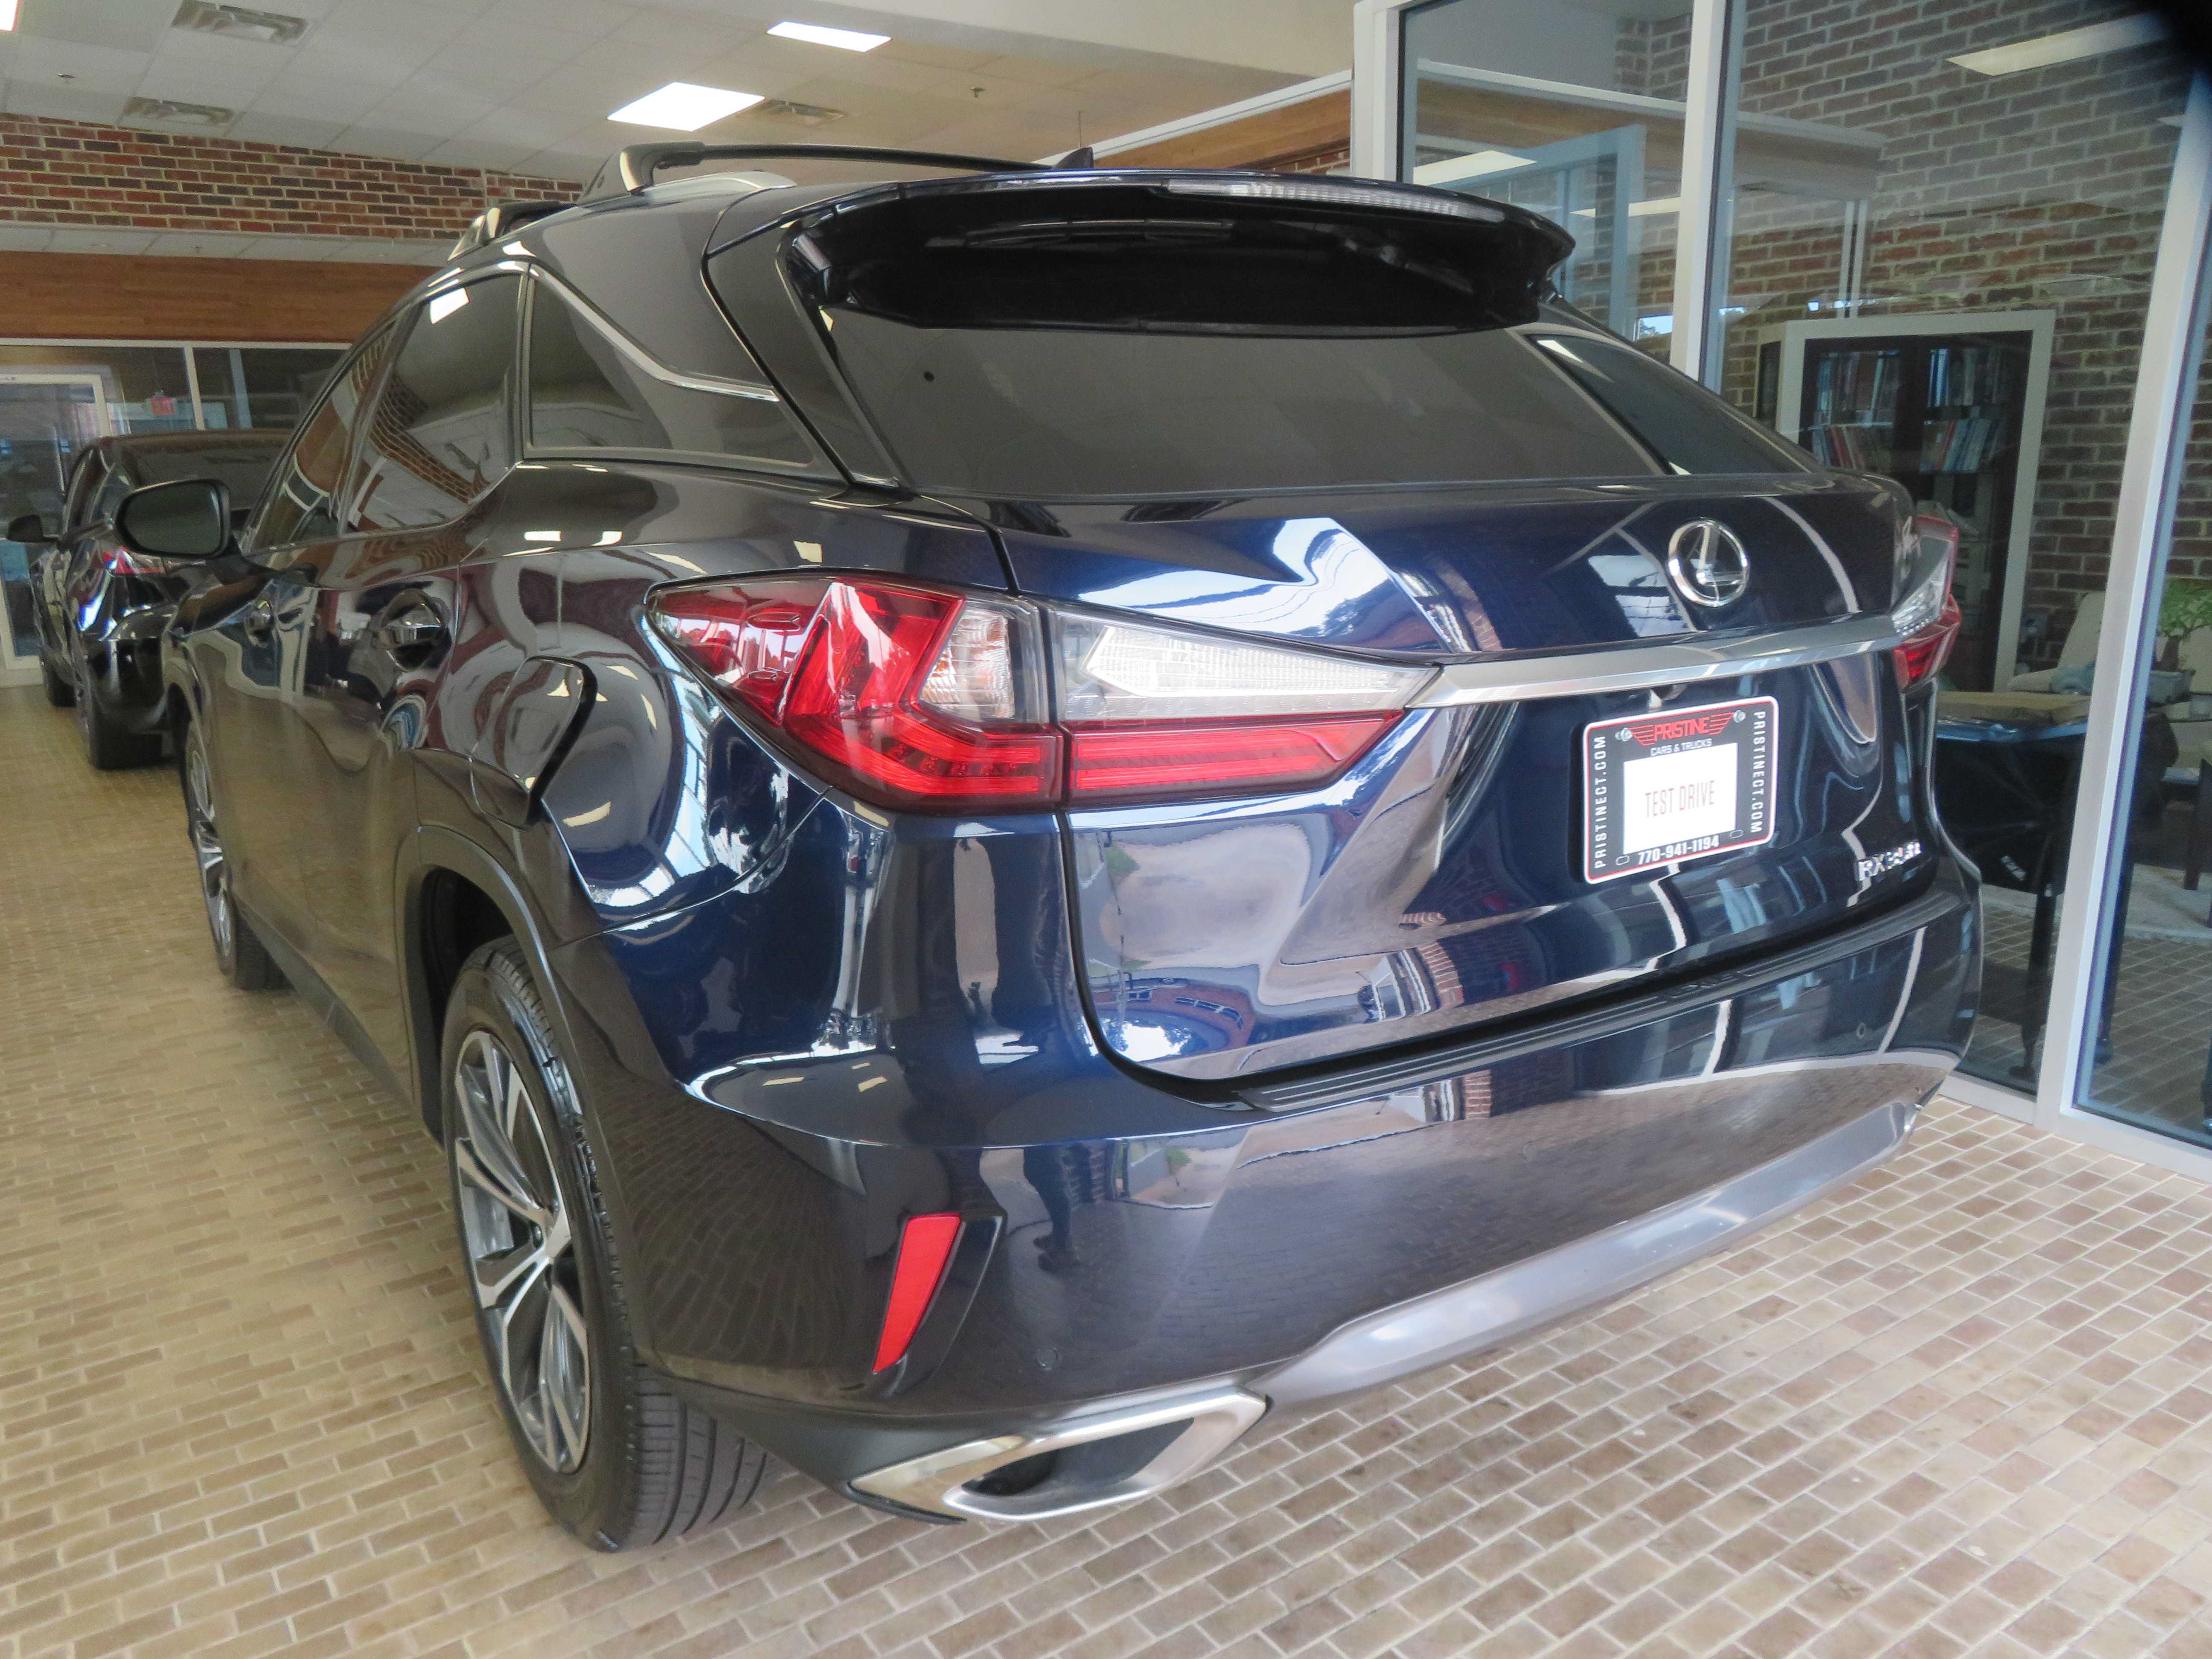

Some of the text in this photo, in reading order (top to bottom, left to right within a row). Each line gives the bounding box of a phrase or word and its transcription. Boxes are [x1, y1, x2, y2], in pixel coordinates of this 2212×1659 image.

[1653, 716, 1710, 741] PRISTINE
[1650, 738, 1712, 756] CARS & TRUCKS
[1750, 711, 1766, 833] PRISTINECT.COM
[1593, 736, 1607, 869] PRISTINECT.COM
[1644, 780, 1715, 818] TEST DRIVE
[1637, 835, 1720, 865] 770-941-1194
